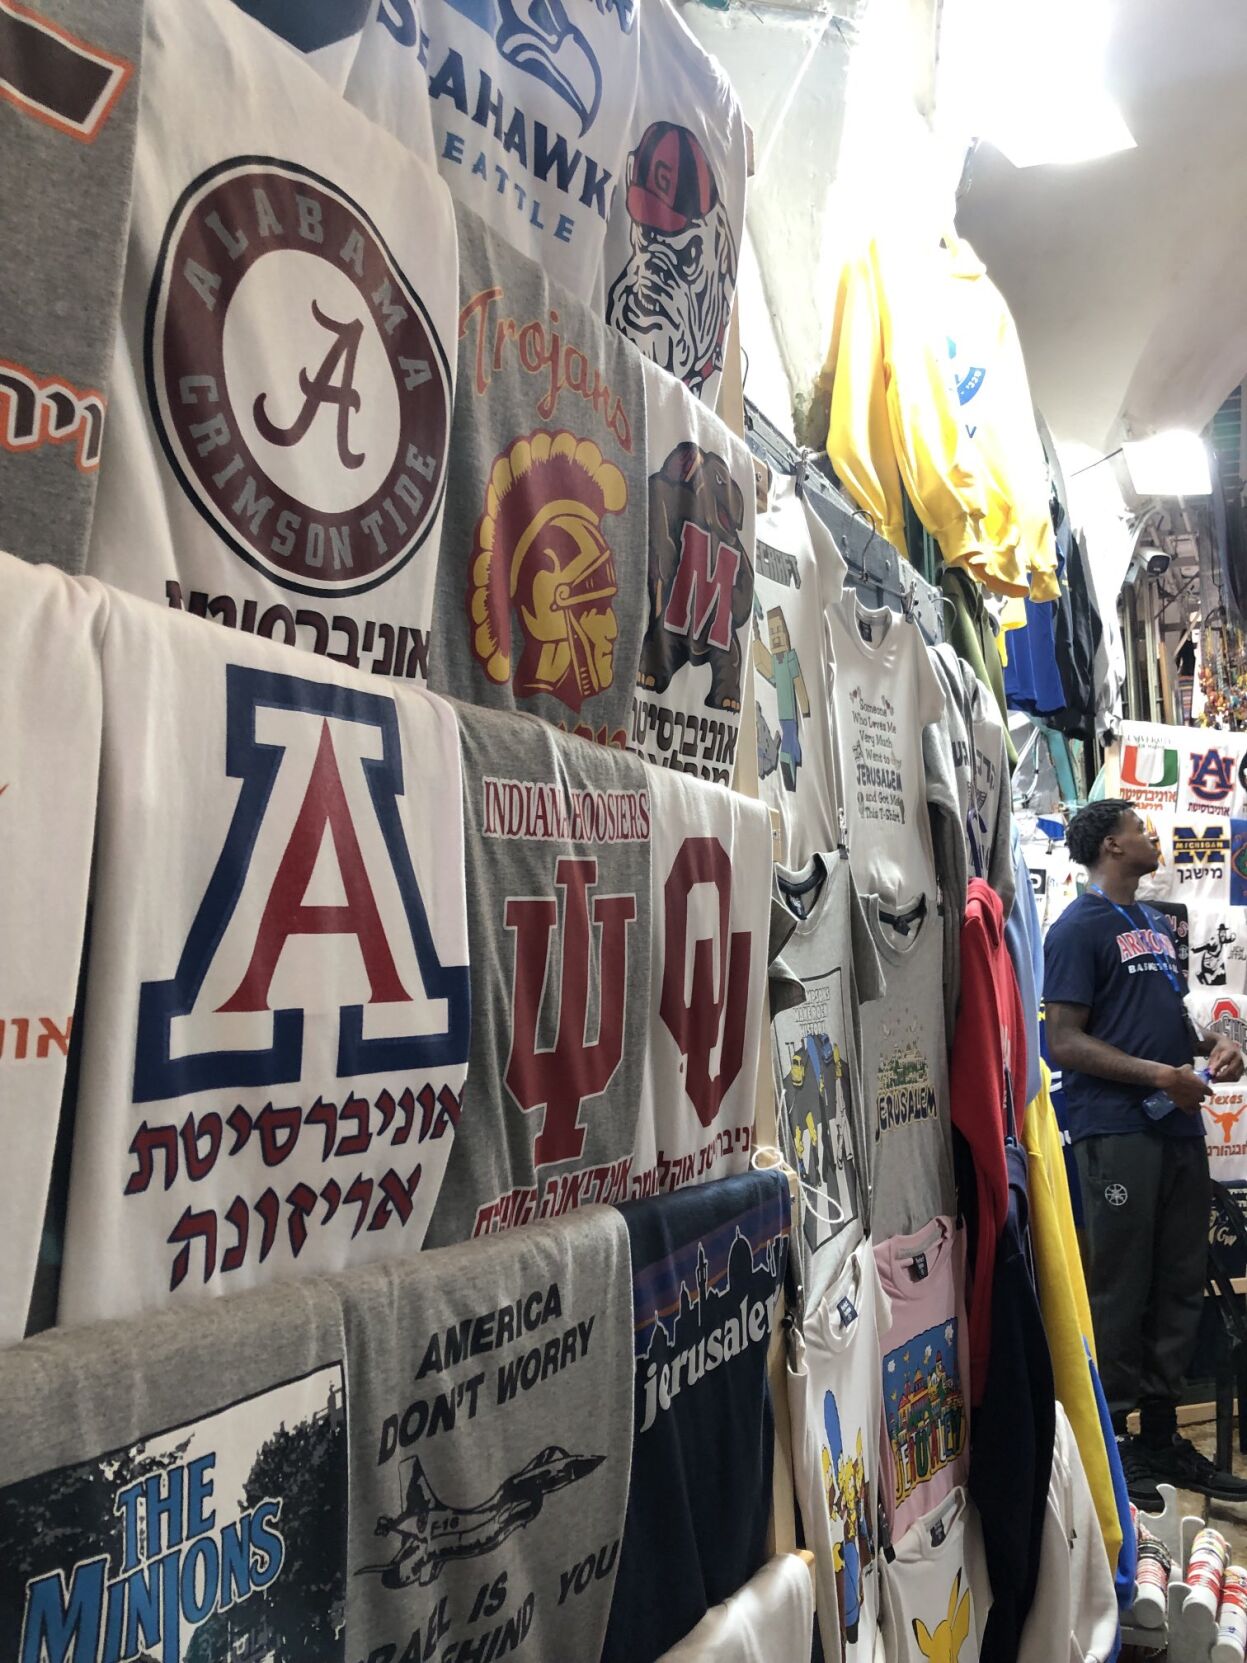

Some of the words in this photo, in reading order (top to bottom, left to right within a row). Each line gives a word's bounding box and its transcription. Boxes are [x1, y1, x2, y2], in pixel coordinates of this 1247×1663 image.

[441, 131, 575, 243] EATTLE
[654, 160, 672, 193] G
[183, 188, 434, 392] ALABAMA
[253, 299, 365, 470] A
[458, 286, 633, 455] Trojans
[178, 374, 354, 571] CRIMSON
[361, 443, 436, 555] TIDE
[664, 520, 741, 652] M
[852, 711, 867, 727] Who
[868, 717, 886, 732] Loves
[886, 721, 897, 735] Me
[859, 699, 888, 717] Someone
[859, 730, 875, 748] Very
[875, 734, 892, 749] Much
[865, 748, 883, 763] Went
[1120, 745, 1178, 787] U
[856, 763, 903, 792] JERUSALEM
[865, 792, 877, 803] and
[878, 791, 889, 805] Got
[571, 791, 650, 843] HOOSIERS
[864, 806, 879, 820] This
[1175, 841, 1224, 850] MICHIGAN
[132, 663, 472, 1104] A
[1177, 867, 1223, 884] מישגן
[0, 1016, 73, 1059] או
[875, 1087, 937, 1143] JERUSALEM
[1210, 1094, 1243, 1105] Texas
[123, 1082, 468, 1196] אוניברסיטת
[167, 1163, 423, 1292] אריזונה
[414, 1283, 562, 1381] AMERICA
[378, 1372, 486, 1466] DON'T
[497, 1315, 596, 1406] WORRY
[113, 1451, 217, 1573] THE
[19, 1497, 286, 1663] MINIONS
[467, 1570, 507, 1625] IS
[557, 1540, 621, 1606] YOU
